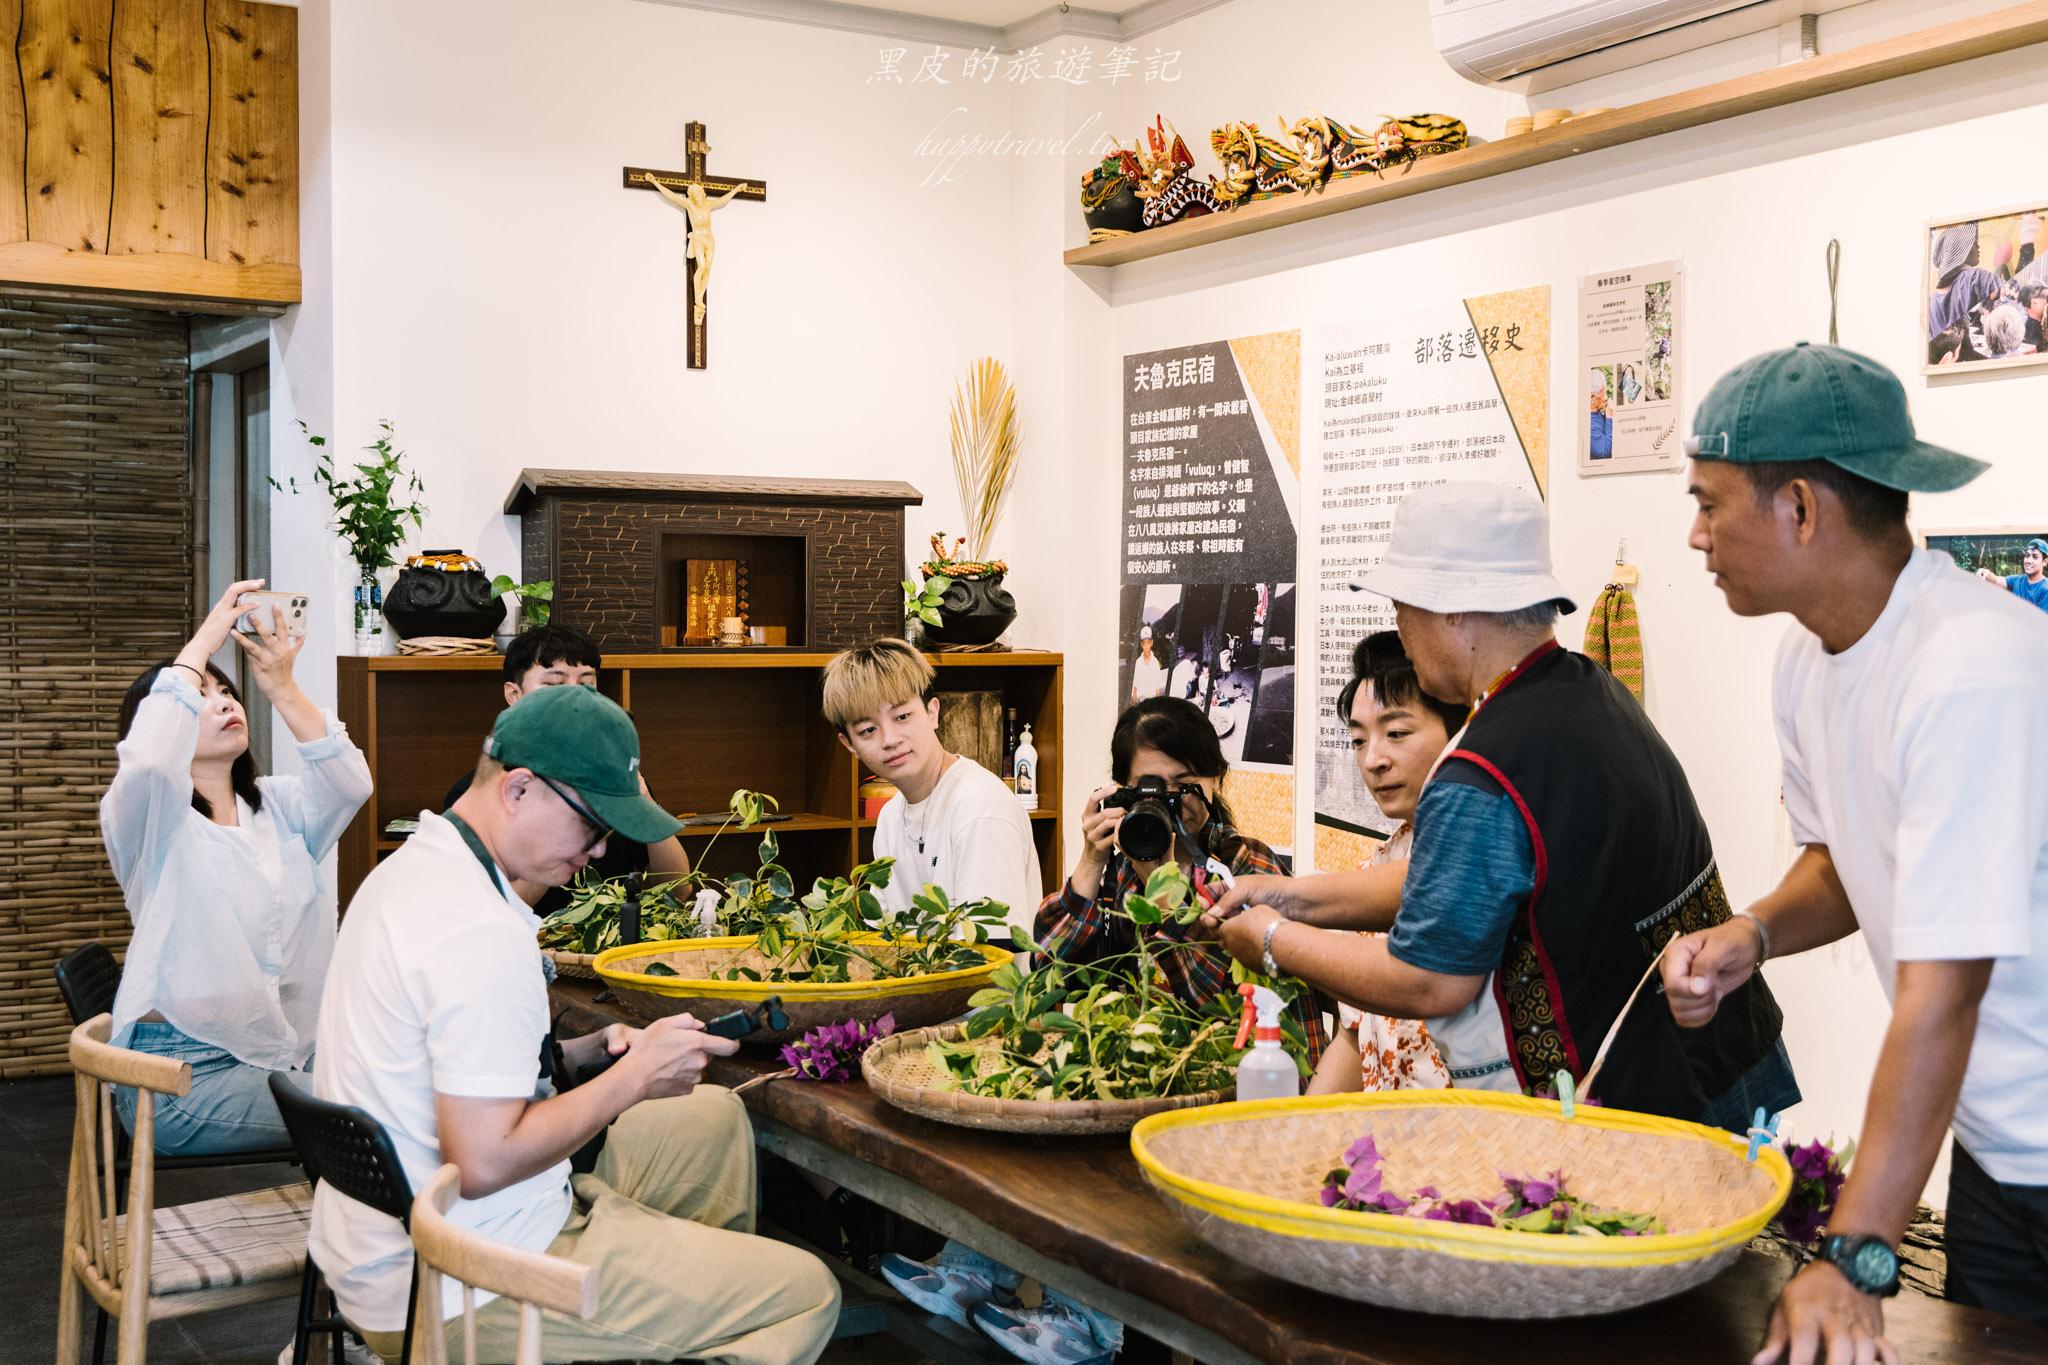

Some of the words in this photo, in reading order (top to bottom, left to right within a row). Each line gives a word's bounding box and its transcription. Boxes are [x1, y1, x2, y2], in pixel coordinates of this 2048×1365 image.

[1414, 322, 1524, 365] 部落遷移史
[1134, 354, 1216, 392] 夫魯克民宿
